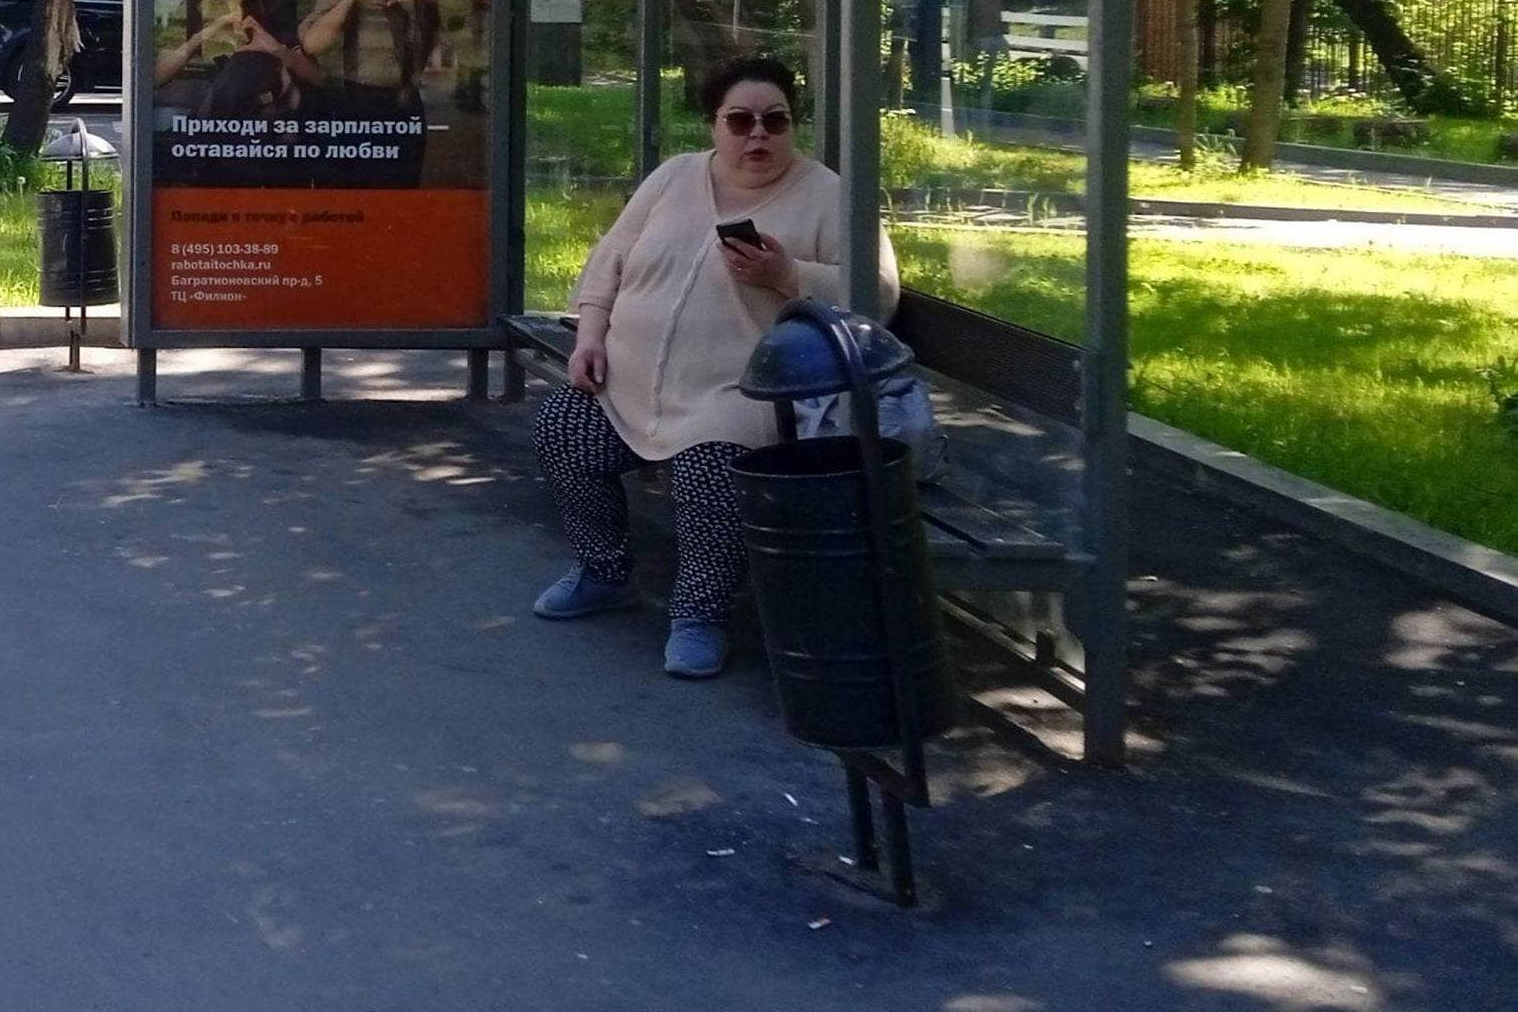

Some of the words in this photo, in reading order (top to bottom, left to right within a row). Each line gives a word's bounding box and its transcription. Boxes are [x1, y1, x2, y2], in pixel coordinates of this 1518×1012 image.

[172, 115, 268, 136] Приходи
[273, 119, 299, 134] за
[305, 116, 422, 137] зарплатой
[172, 139, 287, 158] оставайся
[294, 143, 320, 158] по
[325, 142, 399, 159] любви
[303, 210, 365, 224] работой
[171, 244, 179, 254] 8
[182, 244, 214, 256] (495)
[218, 244, 279, 255] 103-38-89
[171, 260, 271, 270] rabotaitochka.ru
[171, 274, 280, 286] Багратионовский
[315, 275, 323, 285] 5
[171, 291, 186, 303] ТЦ
